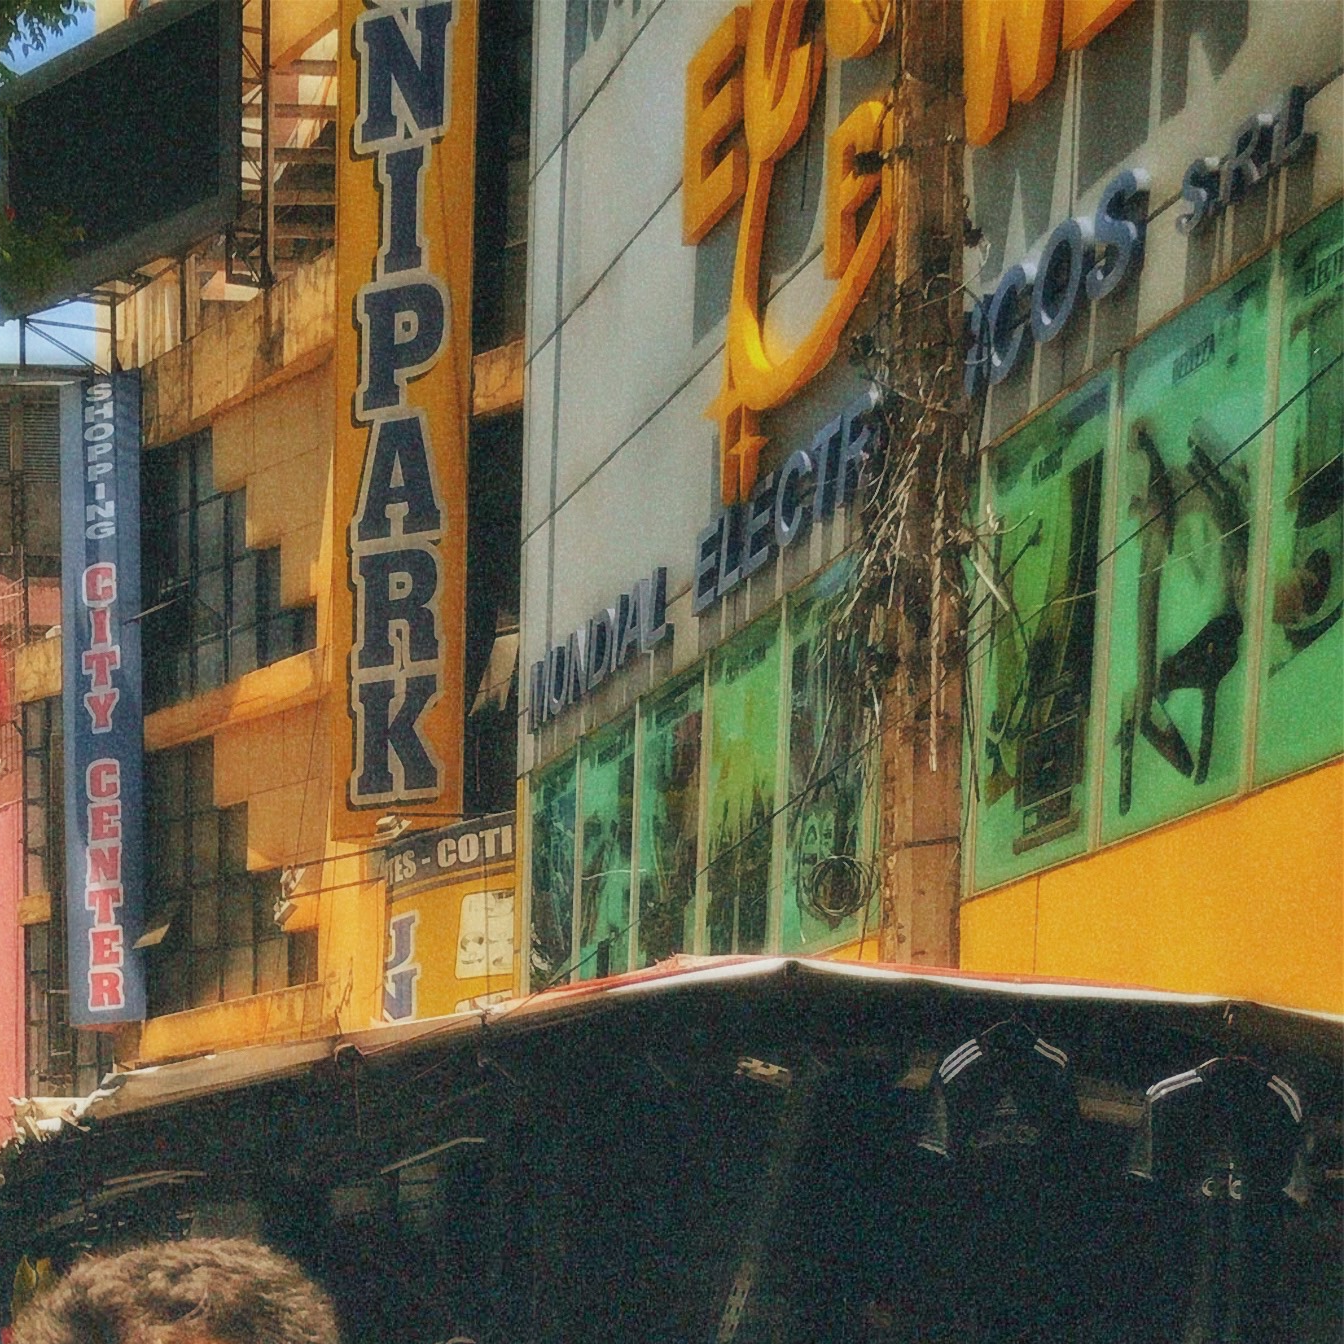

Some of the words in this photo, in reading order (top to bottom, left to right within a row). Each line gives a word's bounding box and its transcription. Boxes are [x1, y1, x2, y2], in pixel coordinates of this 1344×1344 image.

[84, 382, 116, 540] SHOPPING
[353, 0, 458, 808] NIPARK
[81, 562, 121, 733] CITY
[528, 566, 672, 734] MUNDIAL
[85, 758, 125, 1011] CENTER
[380, 850, 416, 886] TES
[437, 825, 513, 868] COTI
